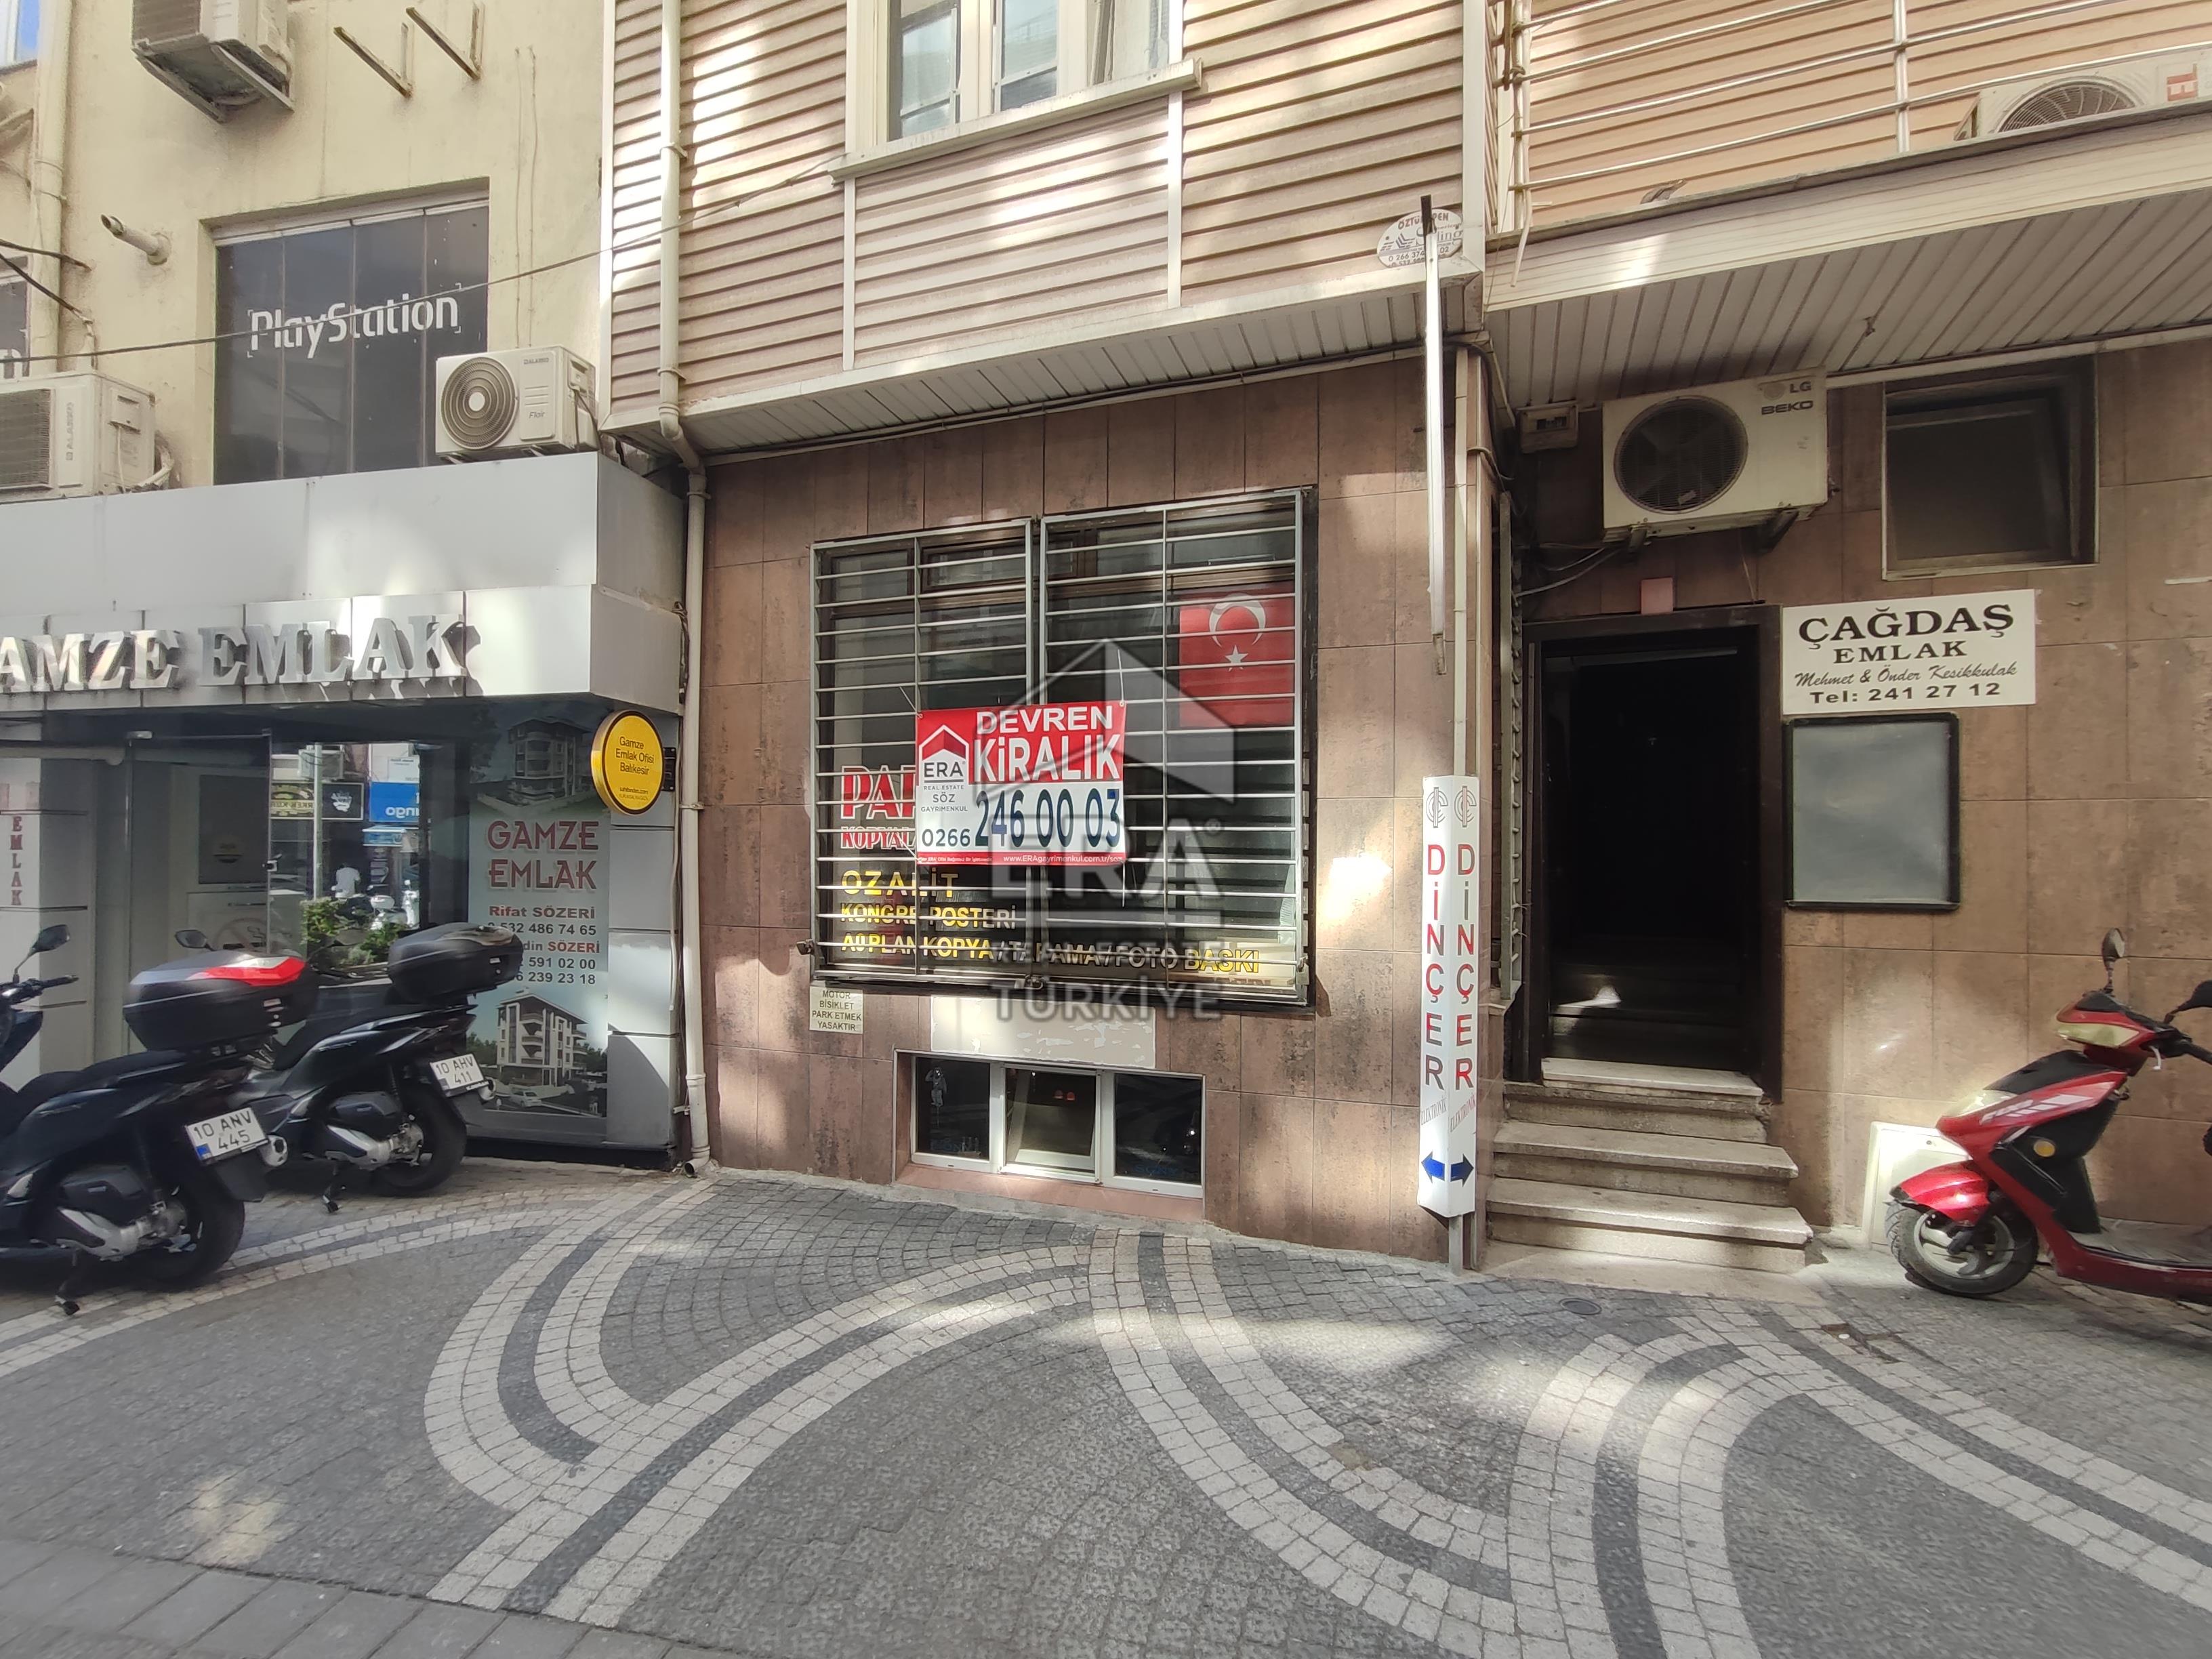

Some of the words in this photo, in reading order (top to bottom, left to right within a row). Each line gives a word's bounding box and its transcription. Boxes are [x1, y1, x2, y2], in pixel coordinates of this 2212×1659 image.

[1395, 253, 1410, 261] 266
[251, 293, 459, 360] PlayStation
[1790, 381, 1811, 393] LG
[1761, 400, 1814, 415] BEKO
[1799, 603, 2014, 650] ÇAĞDAŞ
[0, 630, 179, 693] AMZE
[198, 614, 468, 686] EMLAK
[1833, 640, 1968, 664] EMLAK
[1794, 671, 1856, 687] Mehmet
[1859, 669, 1872, 683] &
[1877, 664, 1922, 682] Önder
[1928, 661, 2018, 679] Kesikkulak
[1809, 690, 1858, 704] Tel:
[1868, 687, 1914, 702] 241
[1925, 684, 1958, 699] 27
[1969, 682, 2001, 697] 12
[976, 705, 1113, 735] DEVREN
[619, 736, 644, 750] Gamze
[615, 747, 638, 762] Emlak
[638, 752, 655, 764] Ofisi
[933, 792, 956, 803] SÖZ
[922, 828, 971, 847] 0266
[975, 790, 1025, 848] 246
[1036, 788, 1074, 848] 00
[1085, 787, 1121, 848] 03
[487, 820, 599, 851] GAMZE
[9, 815, 23, 906] EMLAK
[489, 859, 597, 890] EMLAK
[489, 905, 527, 917] Rifat
[532, 905, 595, 920] SÖZERİ
[528, 922, 554, 934] 486
[558, 924, 575, 935] 74
[579, 924, 596, 936] 65
[547, 939, 600, 954] SÖZERİ
[922, 936, 994, 960] KOPYA
[1115, 945, 1179, 970] FOTO
[1184, 948, 1260, 973] BASKI
[528, 956, 552, 967] 591
[558, 958, 575, 968] 02
[579, 958, 596, 970] 00
[528, 971, 553, 983] 239
[558, 972, 575, 984] 23
[579, 974, 596, 985] 18
[822, 990, 851, 999] MOTOR
[819, 999, 855, 1010] BİSİKLET
[812, 1010, 833, 1019] PARK
[835, 1012, 862, 1021] ETMEK
[817, 1021, 856, 1031] YASAKTIR
[436, 1062, 450, 1075] 10
[454, 1071, 473, 1084] 411
[194, 1122, 215, 1139] 10
[220, 1110, 252, 1132] ANV
[218, 1129, 251, 1150] 445
